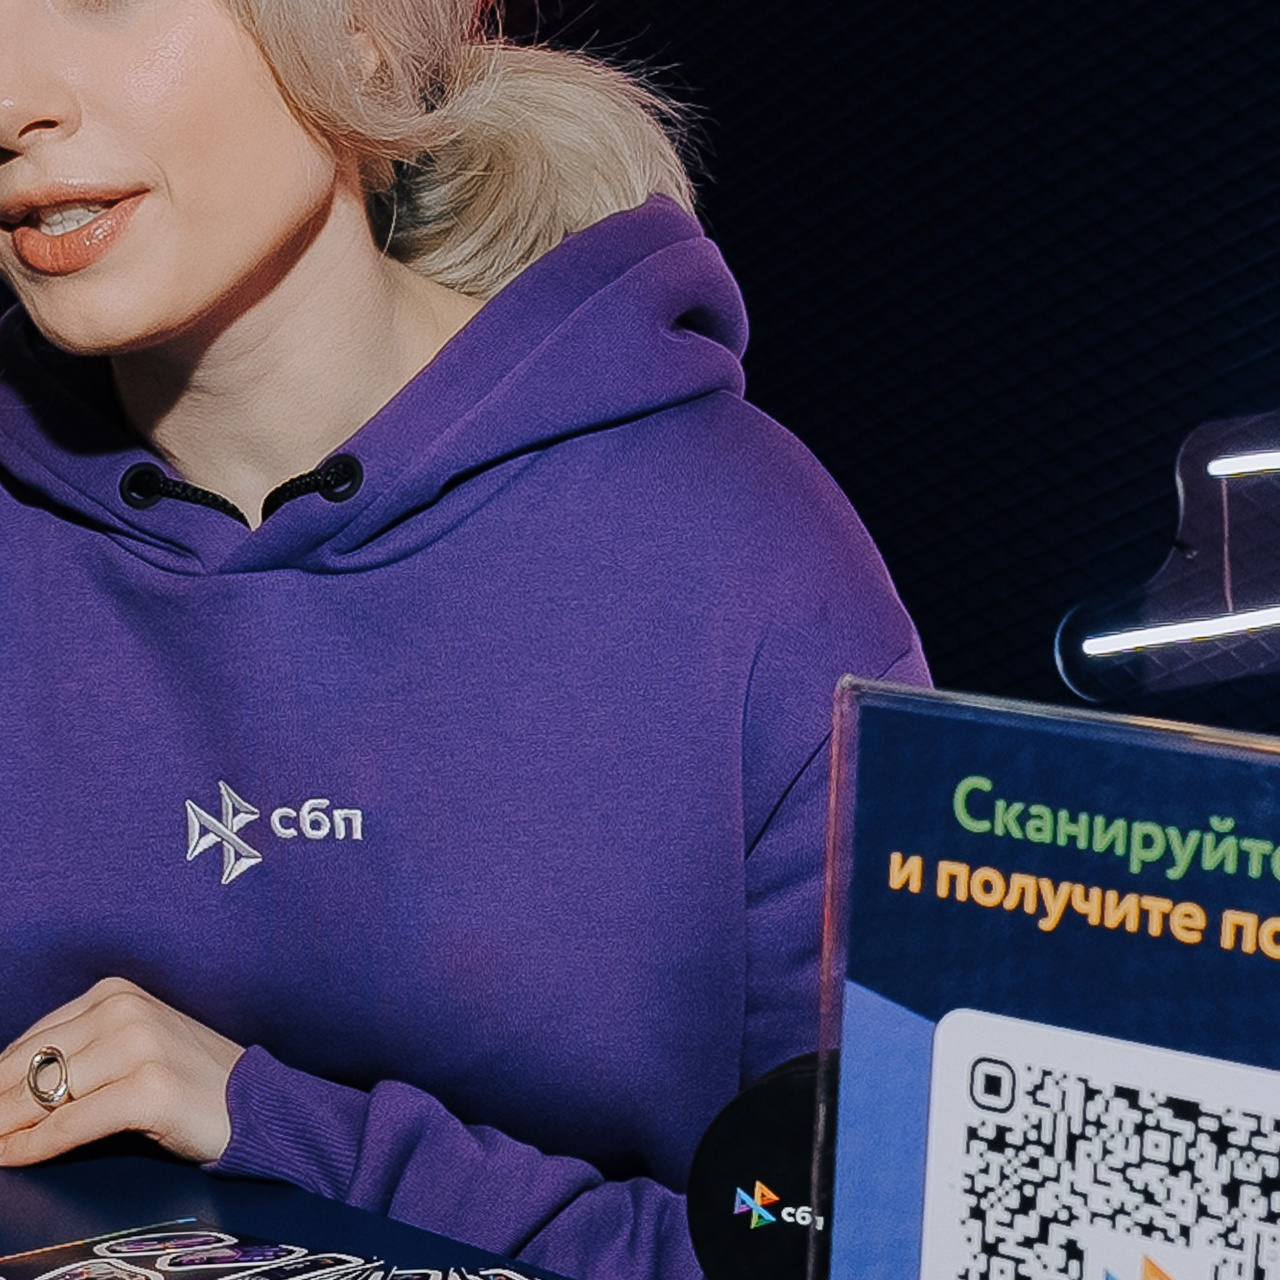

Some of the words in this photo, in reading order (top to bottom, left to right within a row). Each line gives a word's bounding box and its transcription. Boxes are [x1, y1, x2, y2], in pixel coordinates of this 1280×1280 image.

[271, 799, 363, 840] сбп
[953, 775, 1280, 882] Сканируйт
[888, 851, 923, 894] и
[936, 859, 1207, 944] получите
